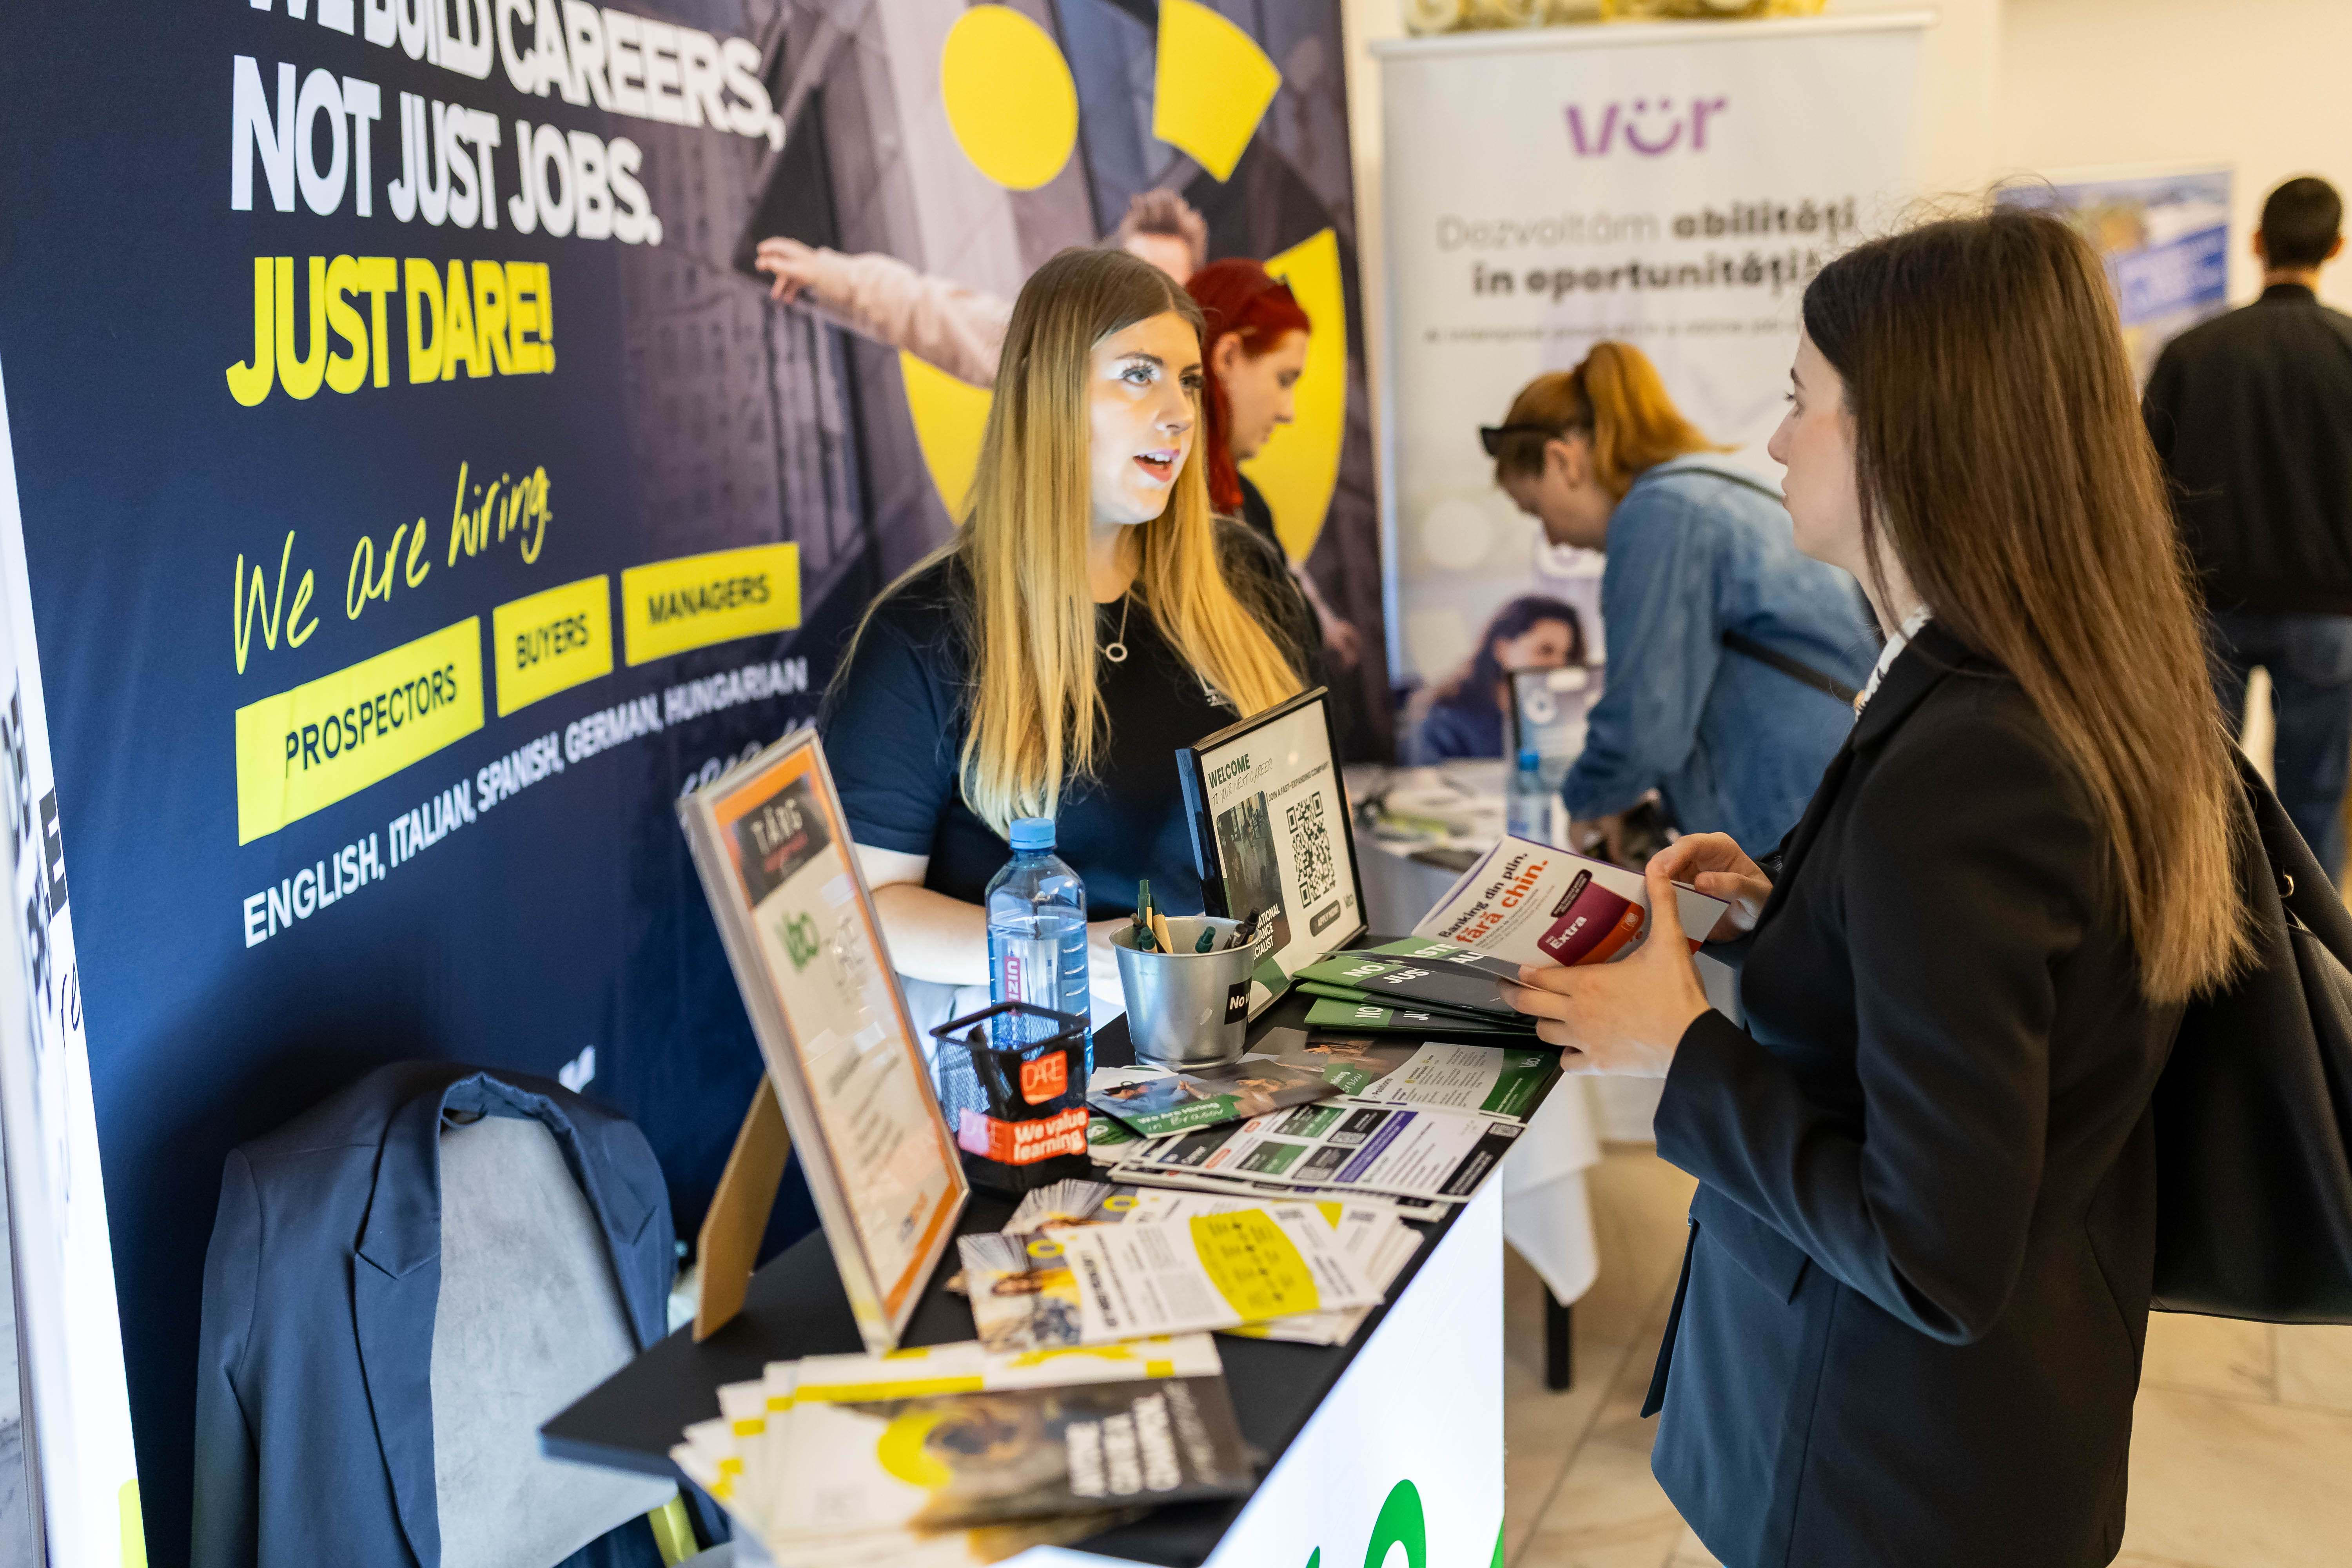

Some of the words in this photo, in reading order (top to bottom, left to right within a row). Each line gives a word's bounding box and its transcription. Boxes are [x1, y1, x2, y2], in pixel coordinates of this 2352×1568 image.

[495, 0, 785, 152] CAREERS,
[231, 54, 381, 217] NOT
[387, 91, 501, 230] JUST
[509, 119, 662, 246] JOBS.
[226, 253, 397, 407] JUST
[405, 257, 555, 384] DARE!
[234, 530, 319, 675] We
[347, 516, 431, 620] are
[647, 573, 771, 626] MANAGERS
[516, 612, 589, 670] BUYERS
[285, 663, 457, 779] PROSPECTORS
[1208, 753, 1250, 789] WELCOME
[1212, 792, 1219, 806] TO
[1220, 782, 1233, 803] YOUR
[1234, 773, 1249, 792] NEXT
[1250, 758, 1273, 784] CAREER
[243, 832, 386, 949] ENGLISH,
[389, 779, 477, 868] ITALIAN,
[476, 730, 564, 813] SPANISH,
[564, 692, 664, 764] GERMAN,
[664, 655, 809, 727] HUNGARIAN
[1269, 792, 1278, 802] JOIN
[1258, 903, 1280, 929] ATIONAL
[1437, 901, 1489, 938] Banking
[1485, 881, 1505, 900] din
[1455, 911, 1504, 944] fără
[1501, 860, 1549, 908] chin.
[1254, 935, 1274, 960] CIALIST
[1257, 921, 1274, 944] ANCE
[1549, 916, 1588, 950] Extra
[1341, 964, 1385, 977] NO
[1382, 968, 1430, 984] JUS
[1229, 995, 1245, 1010] No
[1354, 1007, 1383, 1018] NO
[1403, 1011, 1430, 1020] JU
[1022, 1054, 1063, 1091] DARE
[1014, 1124, 1044, 1143] We
[1045, 1111, 1087, 1136] value
[1014, 1129, 1083, 1162] learning
